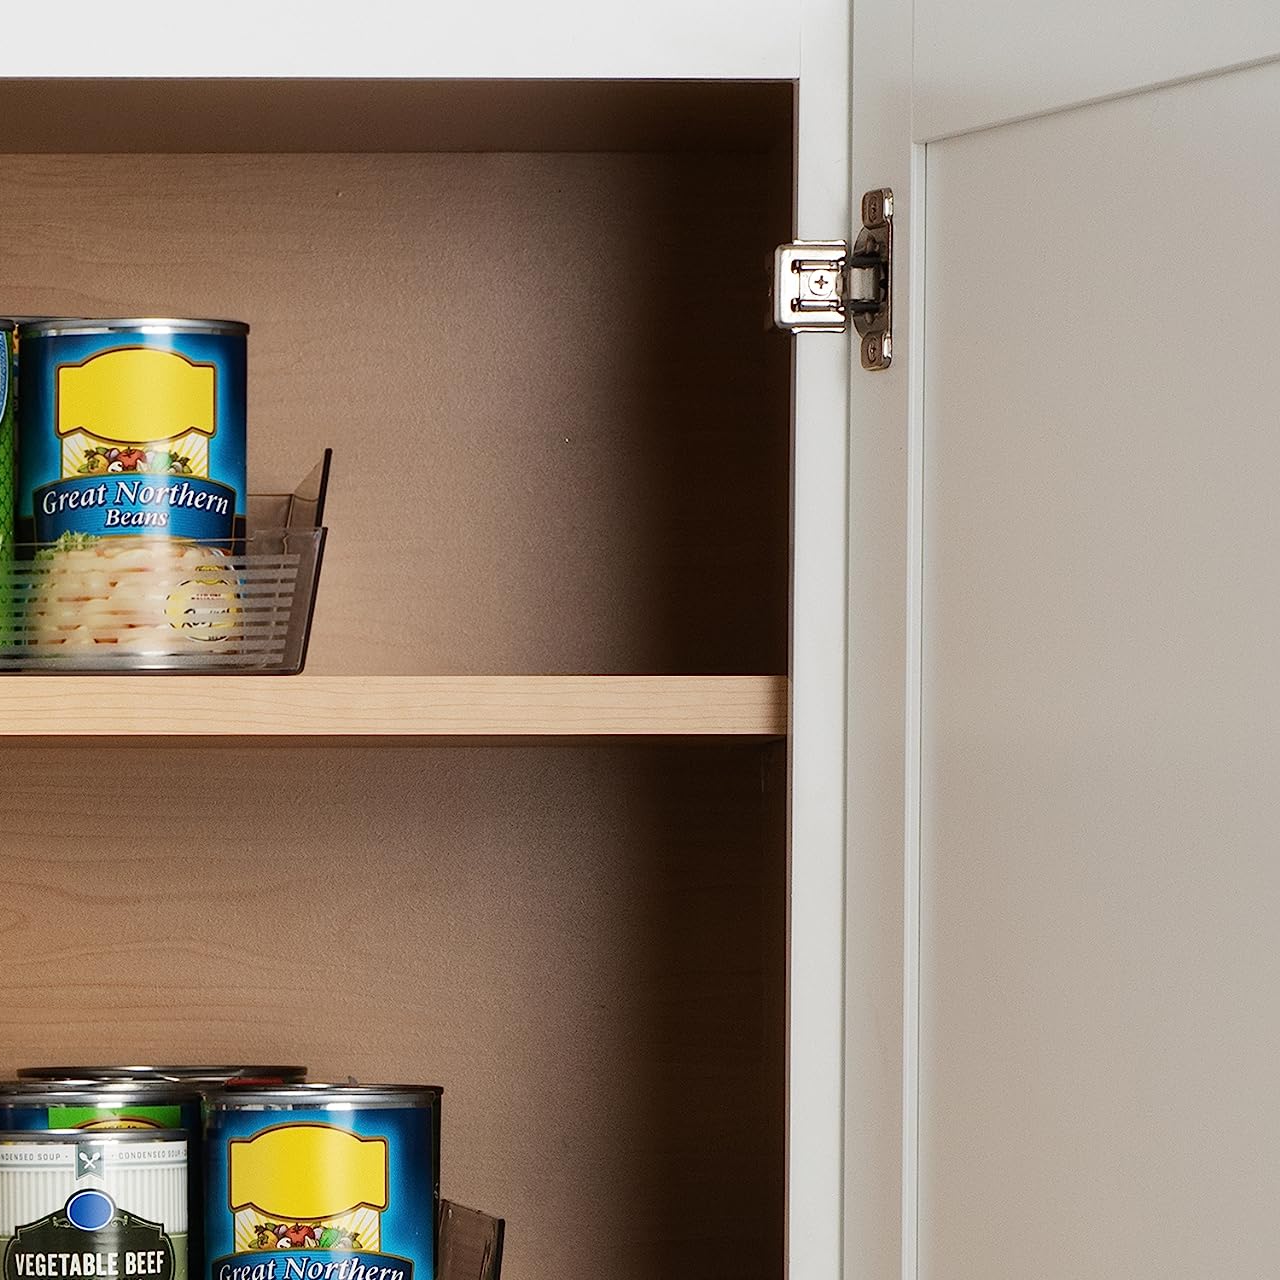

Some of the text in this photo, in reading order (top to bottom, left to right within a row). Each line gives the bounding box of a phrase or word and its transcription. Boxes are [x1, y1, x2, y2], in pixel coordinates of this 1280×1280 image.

[42, 481, 229, 515] Great Northern
[105, 508, 169, 527] Beans
[37, 1153, 61, 1161] SOUP
[15, 1250, 165, 1277] VEGETABLE BEEF
